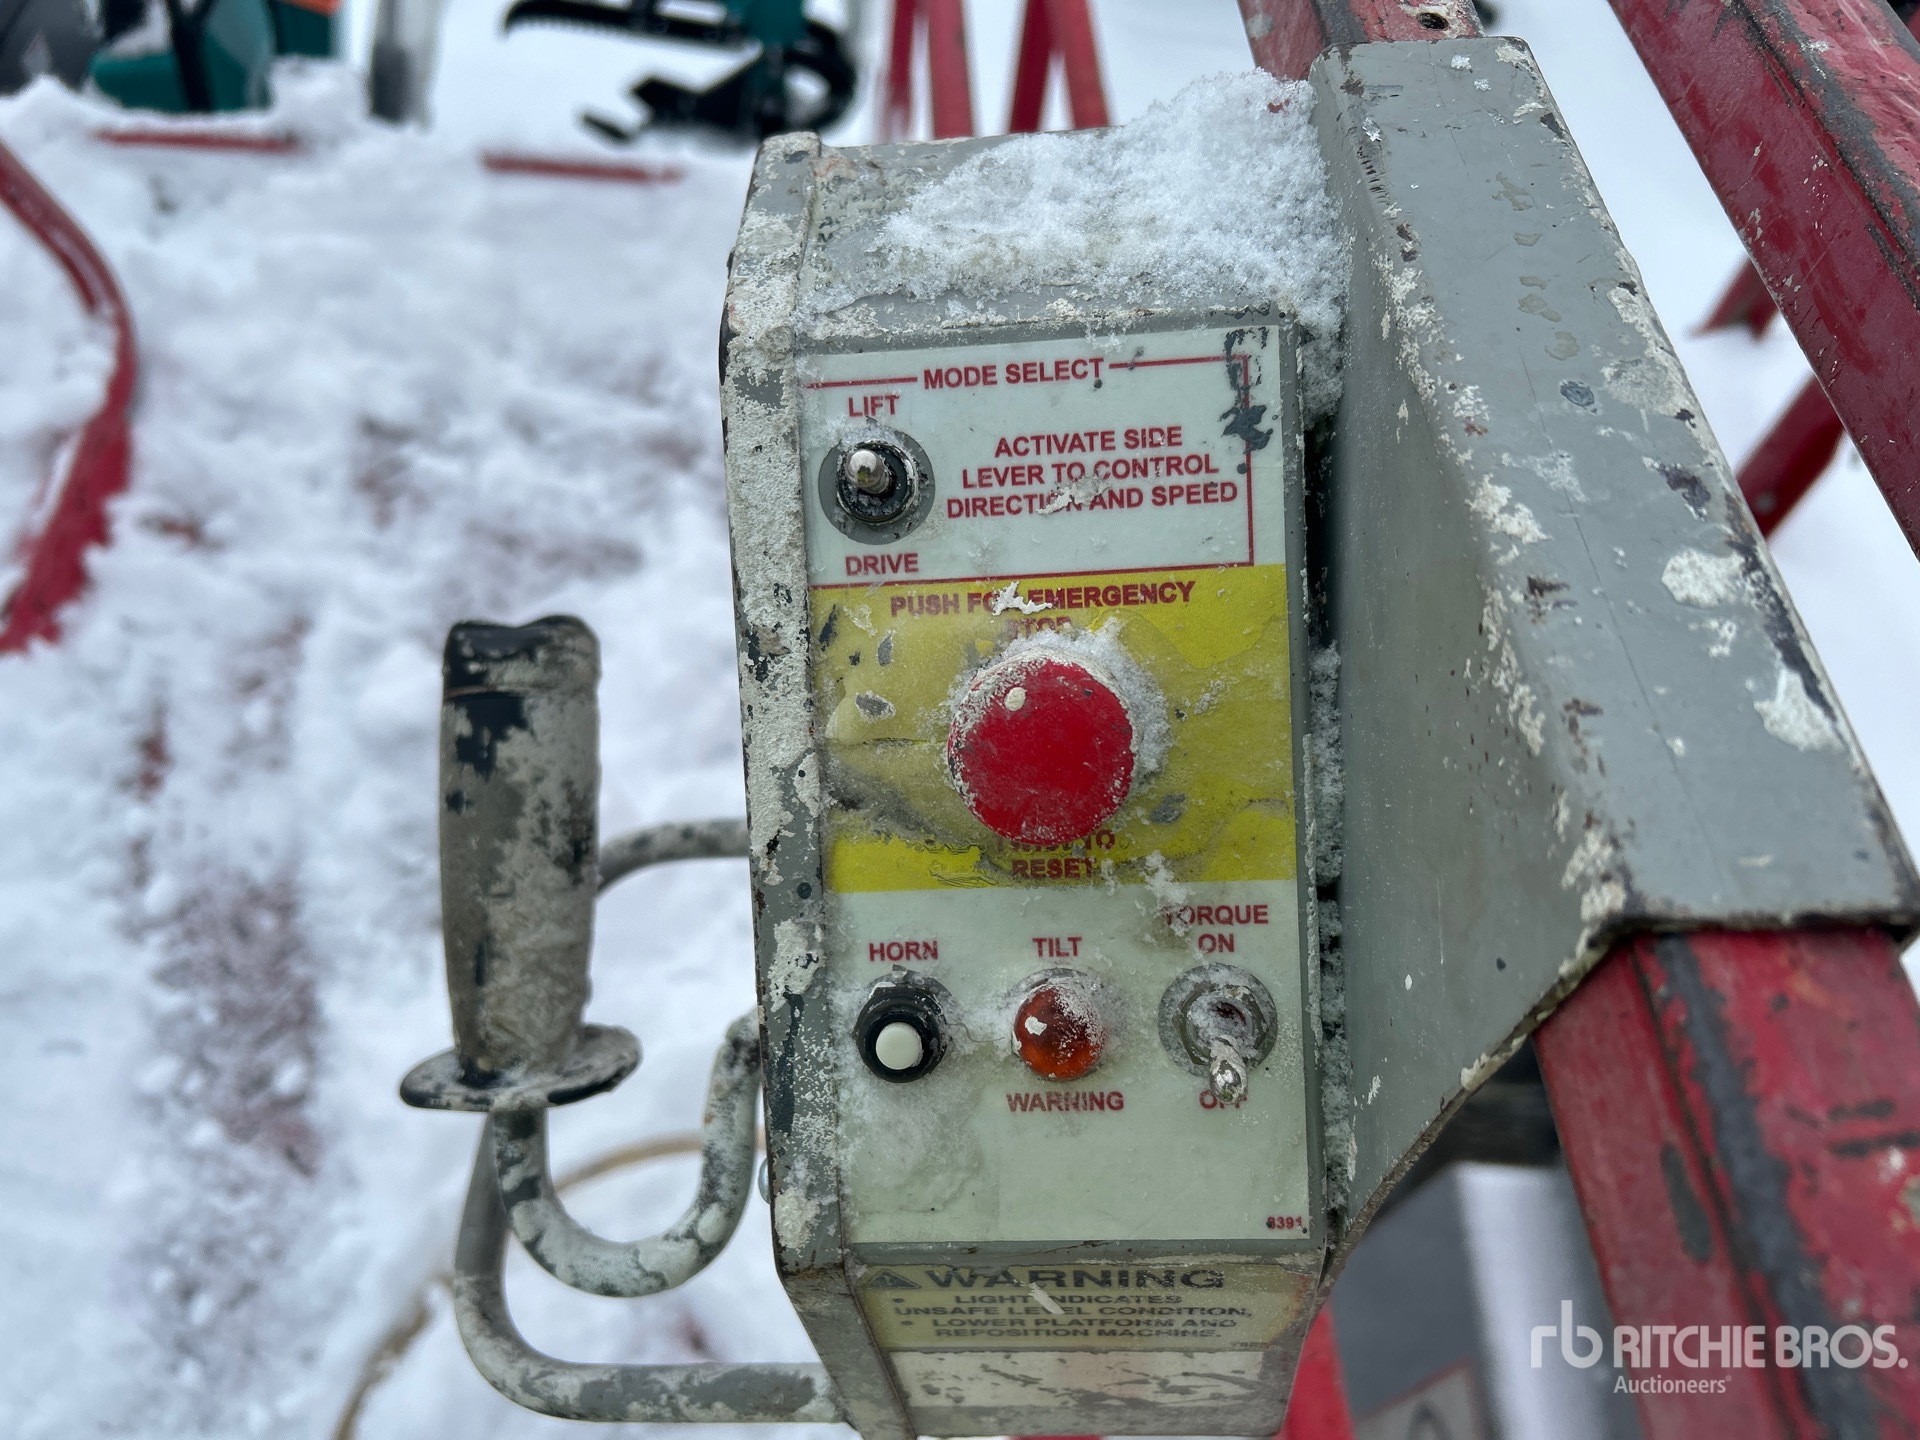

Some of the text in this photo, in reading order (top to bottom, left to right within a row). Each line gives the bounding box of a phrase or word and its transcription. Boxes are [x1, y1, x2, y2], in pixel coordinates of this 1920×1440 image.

[923, 357, 1105, 390] MODE SELECT
[848, 394, 901, 418] LIFT
[994, 425, 1183, 459] ACTIVATE SIDE
[961, 453, 1220, 490] LEVER TO CONTROL
[947, 481, 1239, 519] DIRECTIN AND SPEED
[844, 552, 919, 577] DRIVE
[890, 580, 1196, 617] PUSH FO EMERGENCY
[1010, 857, 1097, 880] RESET
[1161, 903, 1269, 926] TORQUE
[868, 940, 939, 962] HORN
[1031, 936, 1083, 958] TILT
[1197, 932, 1235, 953] ON
[1005, 1090, 1125, 1114] WARNING
[924, 1268, 1225, 1290] WARNING
[954, 1294, 1183, 1304] LIGHT NDICATES
[895, 1306, 1001, 1316] UNSAFE
[932, 1318, 1238, 1328] LOWER PLATFORM AND
[934, 1328, 1222, 1338] REPOSITION MACHINE.
